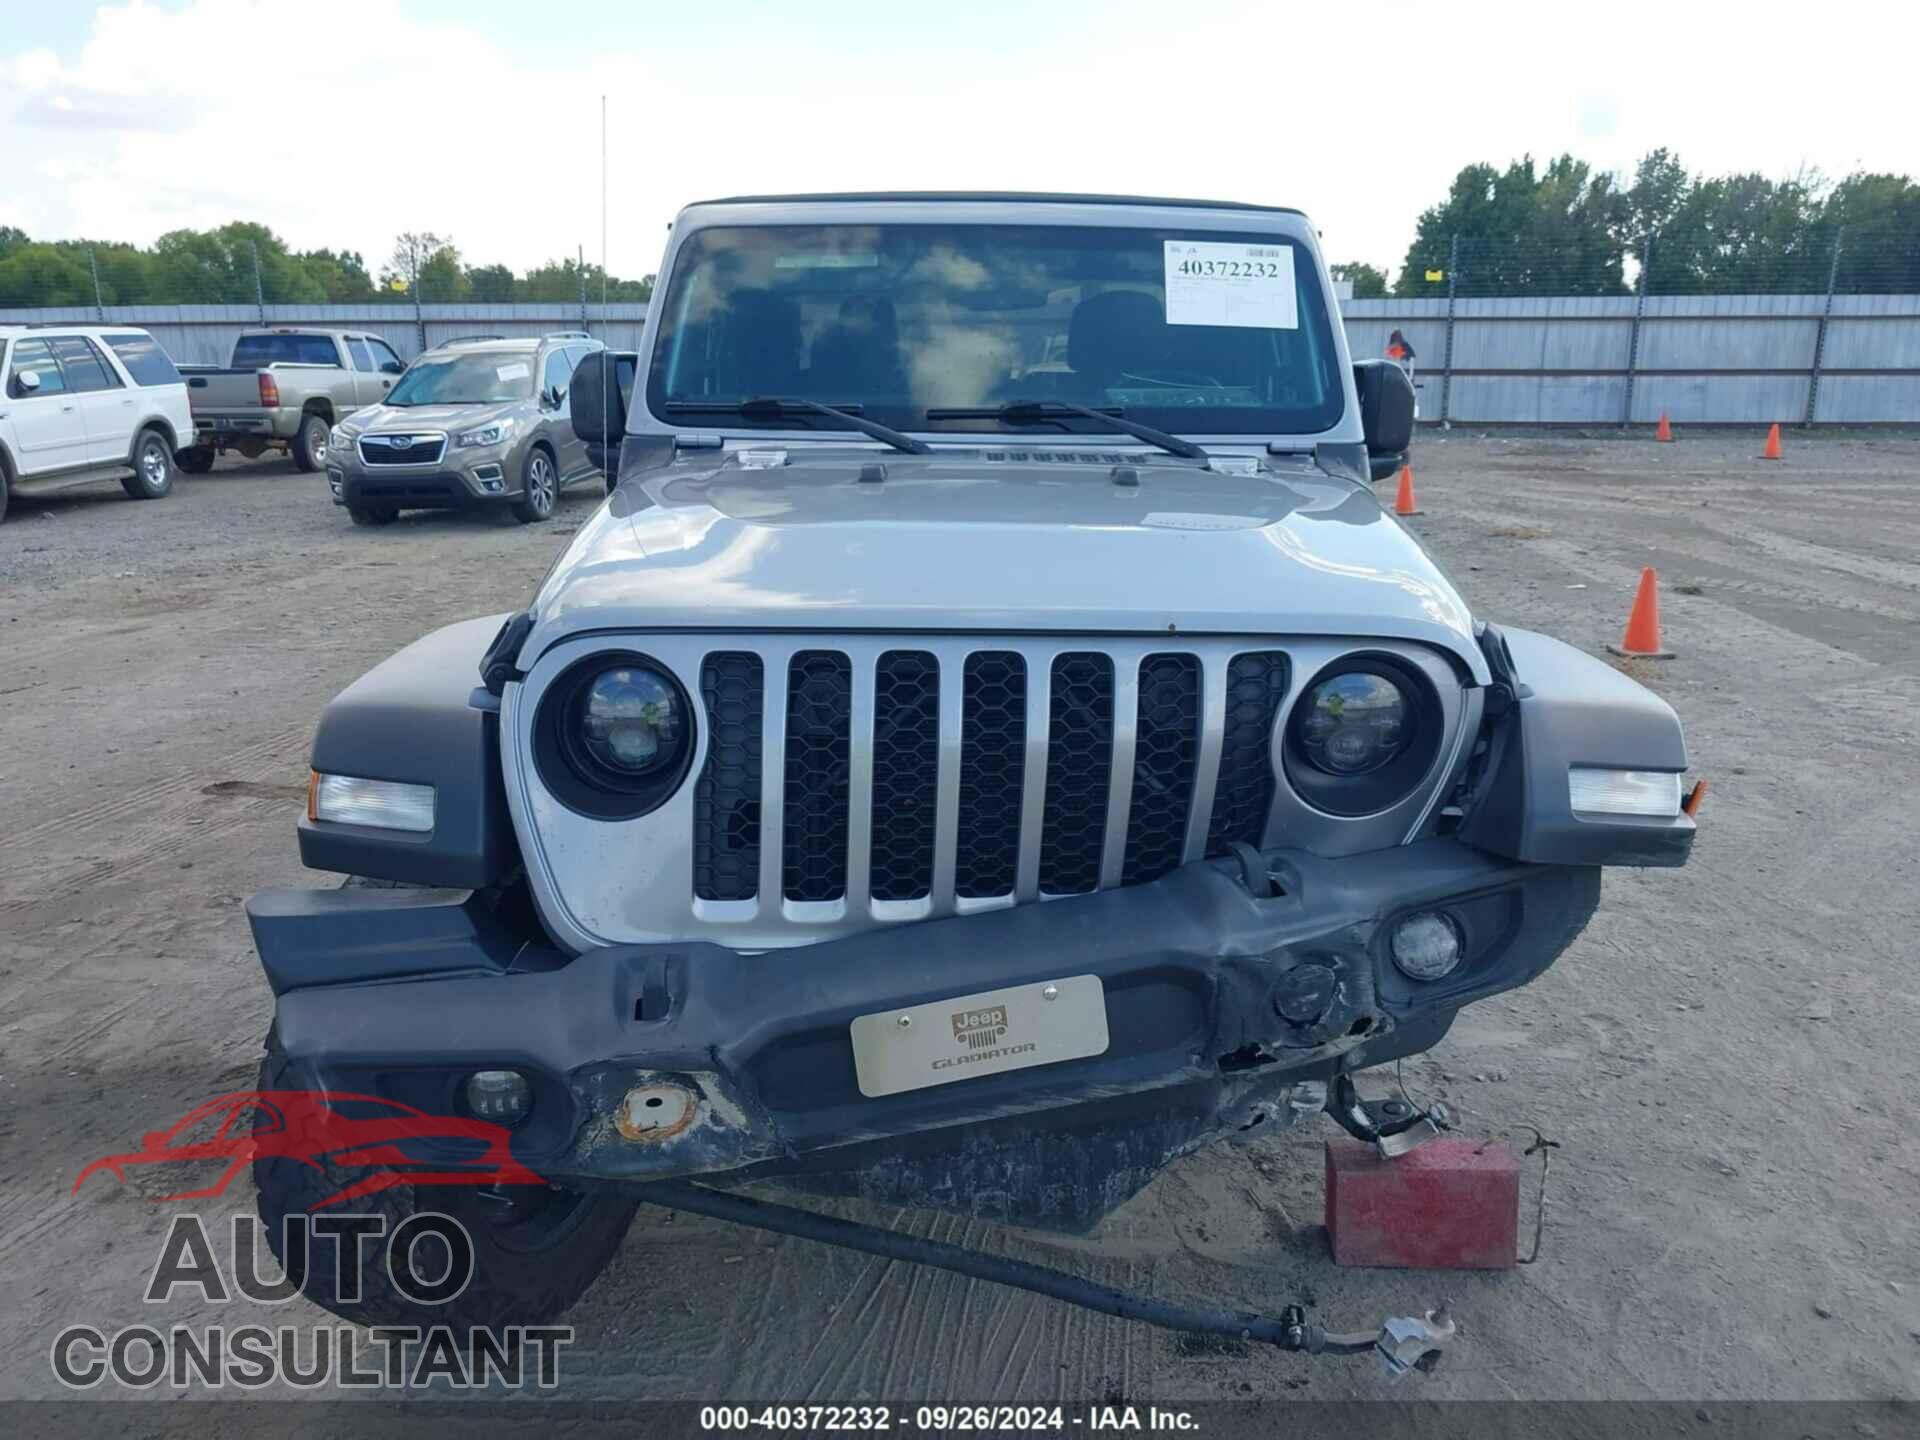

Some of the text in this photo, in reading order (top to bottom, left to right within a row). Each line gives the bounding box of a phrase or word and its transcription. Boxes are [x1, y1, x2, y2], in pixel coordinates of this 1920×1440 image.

[1178, 260, 1278, 278] 40372232
[956, 1008, 1003, 1030] Jeep
[931, 1043, 1036, 1070] GLADIATOR
